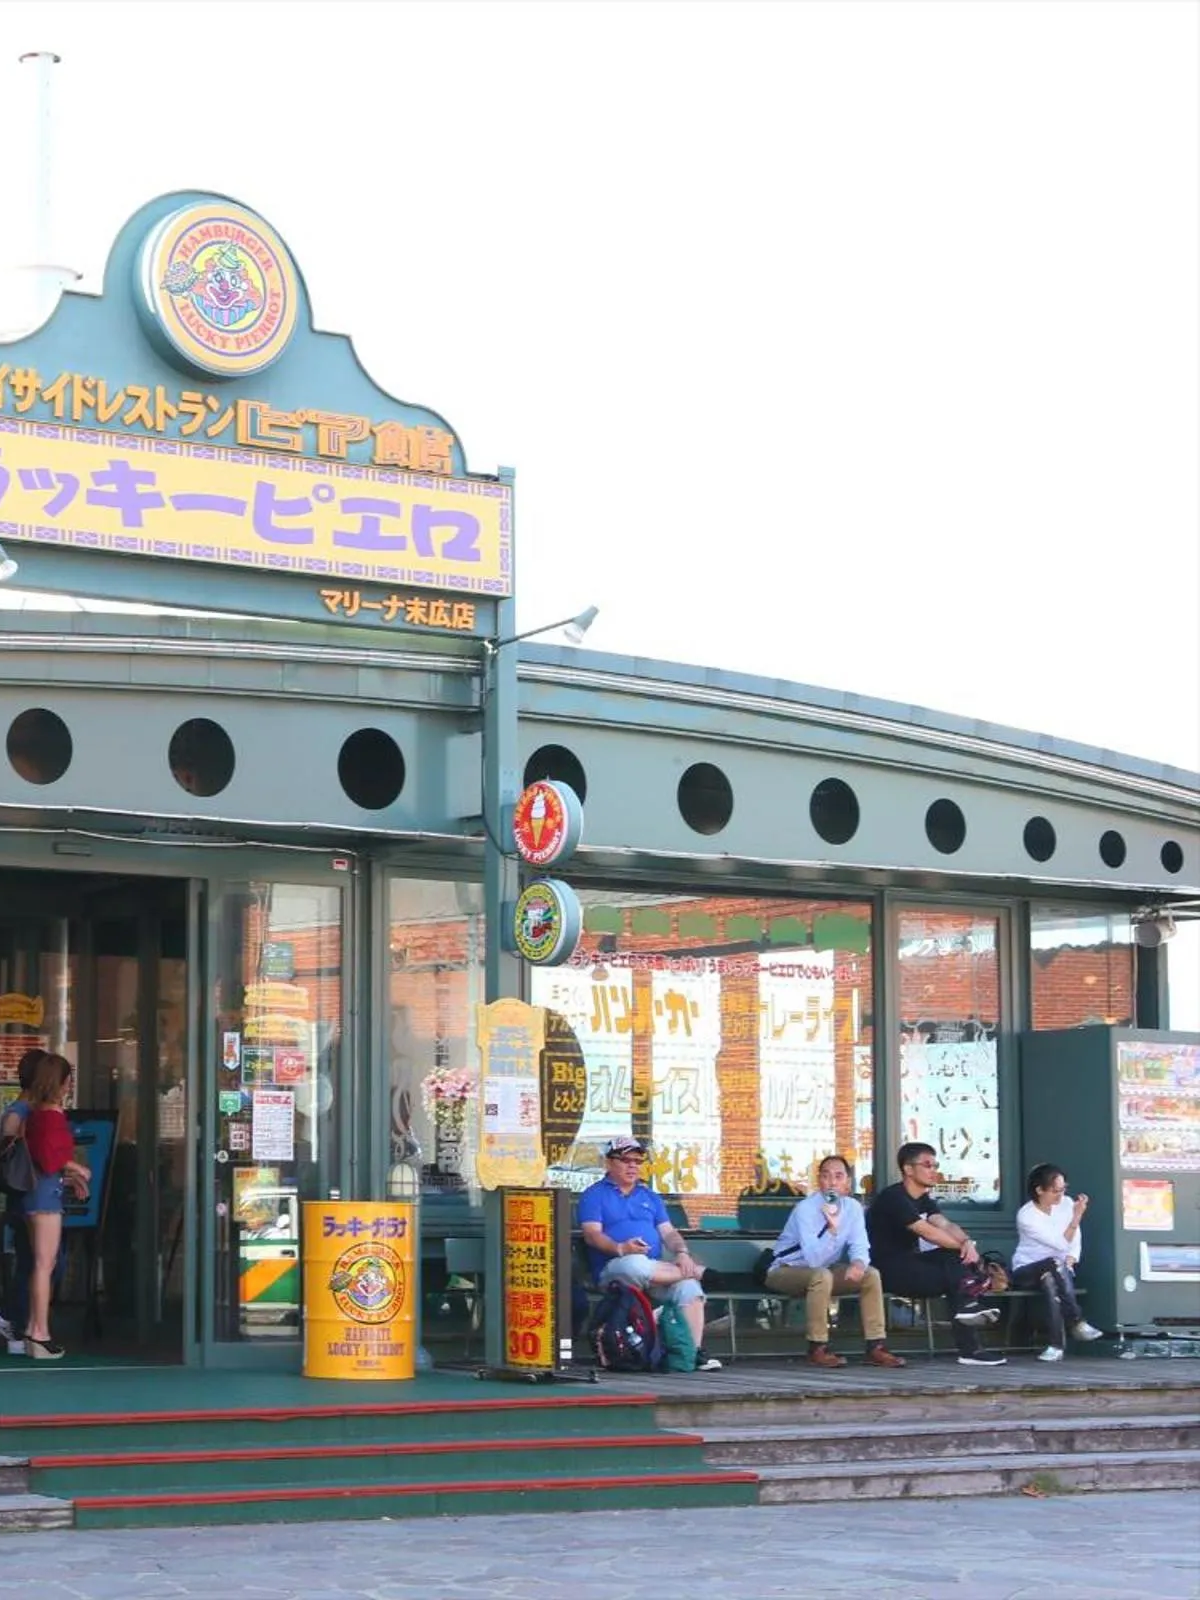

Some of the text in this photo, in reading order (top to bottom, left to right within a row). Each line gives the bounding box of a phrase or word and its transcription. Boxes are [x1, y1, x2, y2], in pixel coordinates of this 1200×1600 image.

[178, 224, 274, 272] HAMBURGER
[179, 288, 282, 350] LUCKY PIERROT
[320, 588, 476, 631] マリーナ末広店
[551, 1061, 585, 1090] Big
[589, 1064, 702, 1115] オムライス
